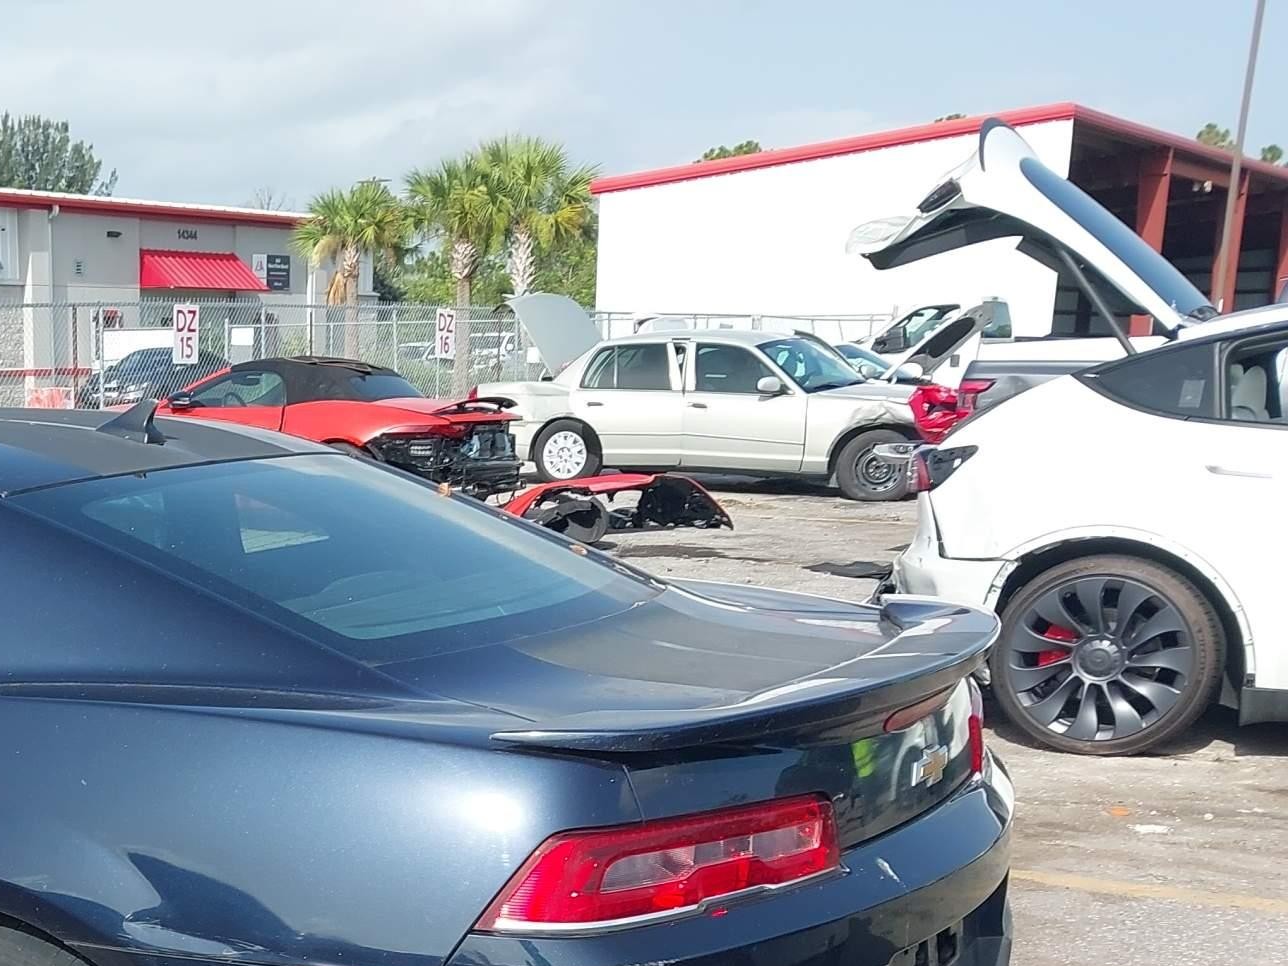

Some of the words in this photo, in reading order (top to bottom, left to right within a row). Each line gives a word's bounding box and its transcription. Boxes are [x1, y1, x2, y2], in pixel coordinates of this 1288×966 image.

[176, 309, 197, 333] DZ
[438, 312, 454, 333] DZ
[180, 336, 194, 359] 15
[439, 335, 450, 354] 16
